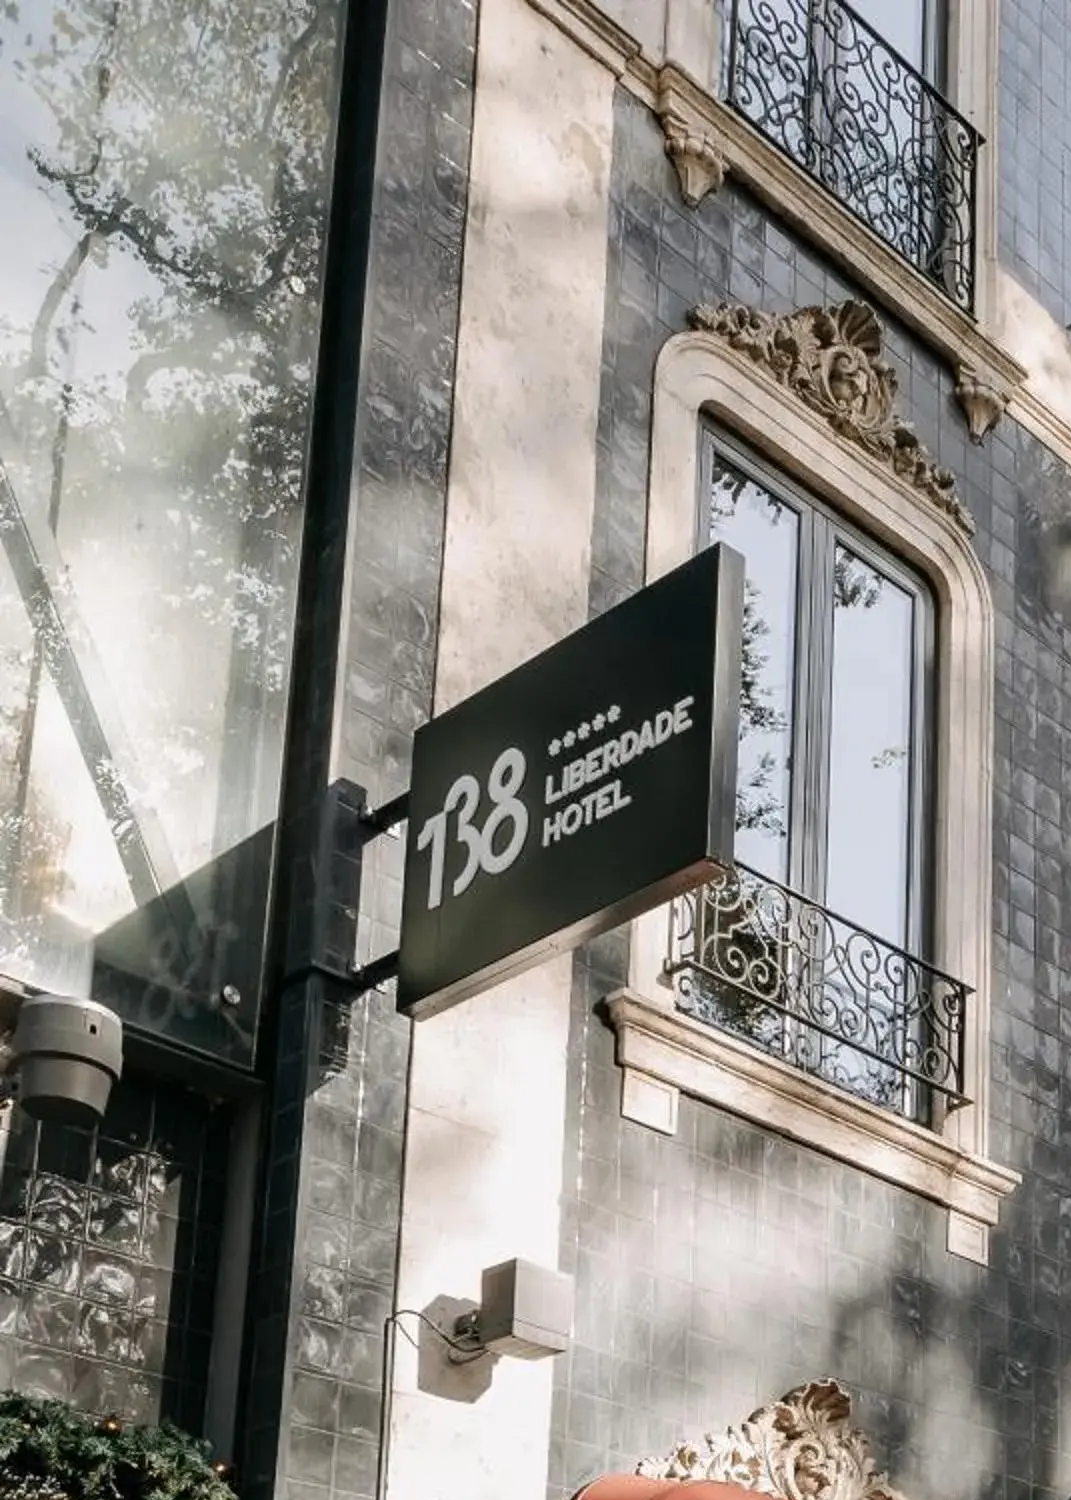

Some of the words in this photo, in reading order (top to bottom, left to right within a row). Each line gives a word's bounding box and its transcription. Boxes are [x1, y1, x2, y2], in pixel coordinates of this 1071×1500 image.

[544, 696, 694, 804] LIBERDADE
[417, 747, 529, 910] 138
[542, 779, 632, 847] HOTEL
